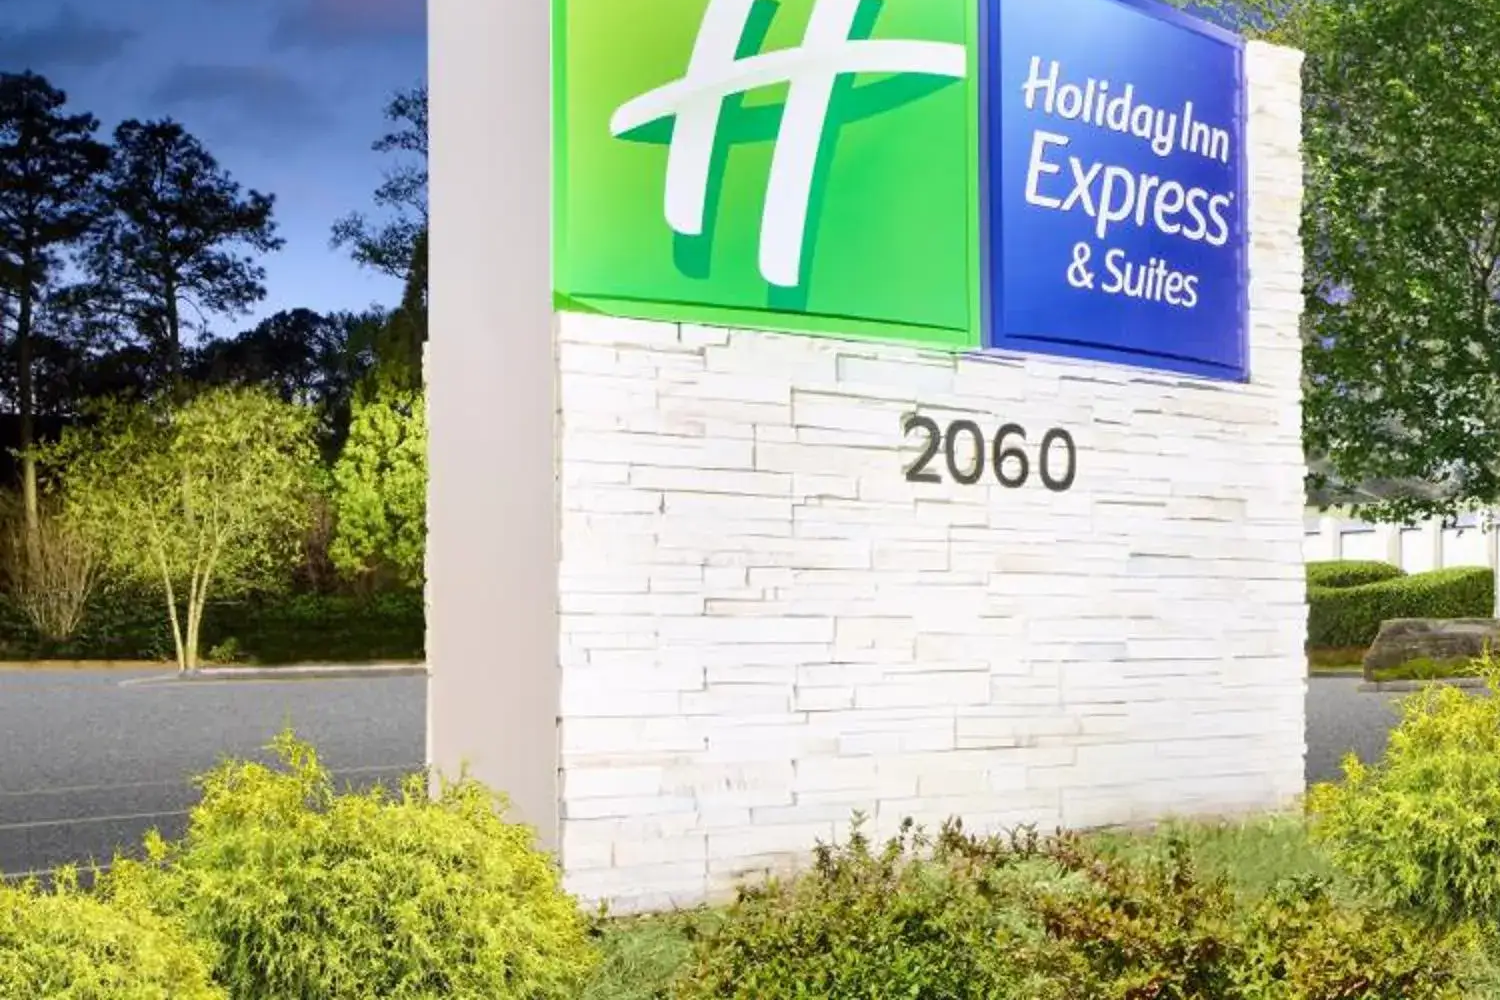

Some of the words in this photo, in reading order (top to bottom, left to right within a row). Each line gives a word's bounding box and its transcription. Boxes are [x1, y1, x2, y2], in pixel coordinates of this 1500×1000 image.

[1022, 56, 1177, 157] Holiday
[1180, 101, 1229, 163] Inn
[1025, 129, 1231, 246] Express
[1067, 241, 1095, 290] &
[1101, 247, 1199, 309] Suites
[903, 415, 1077, 493] 2060
